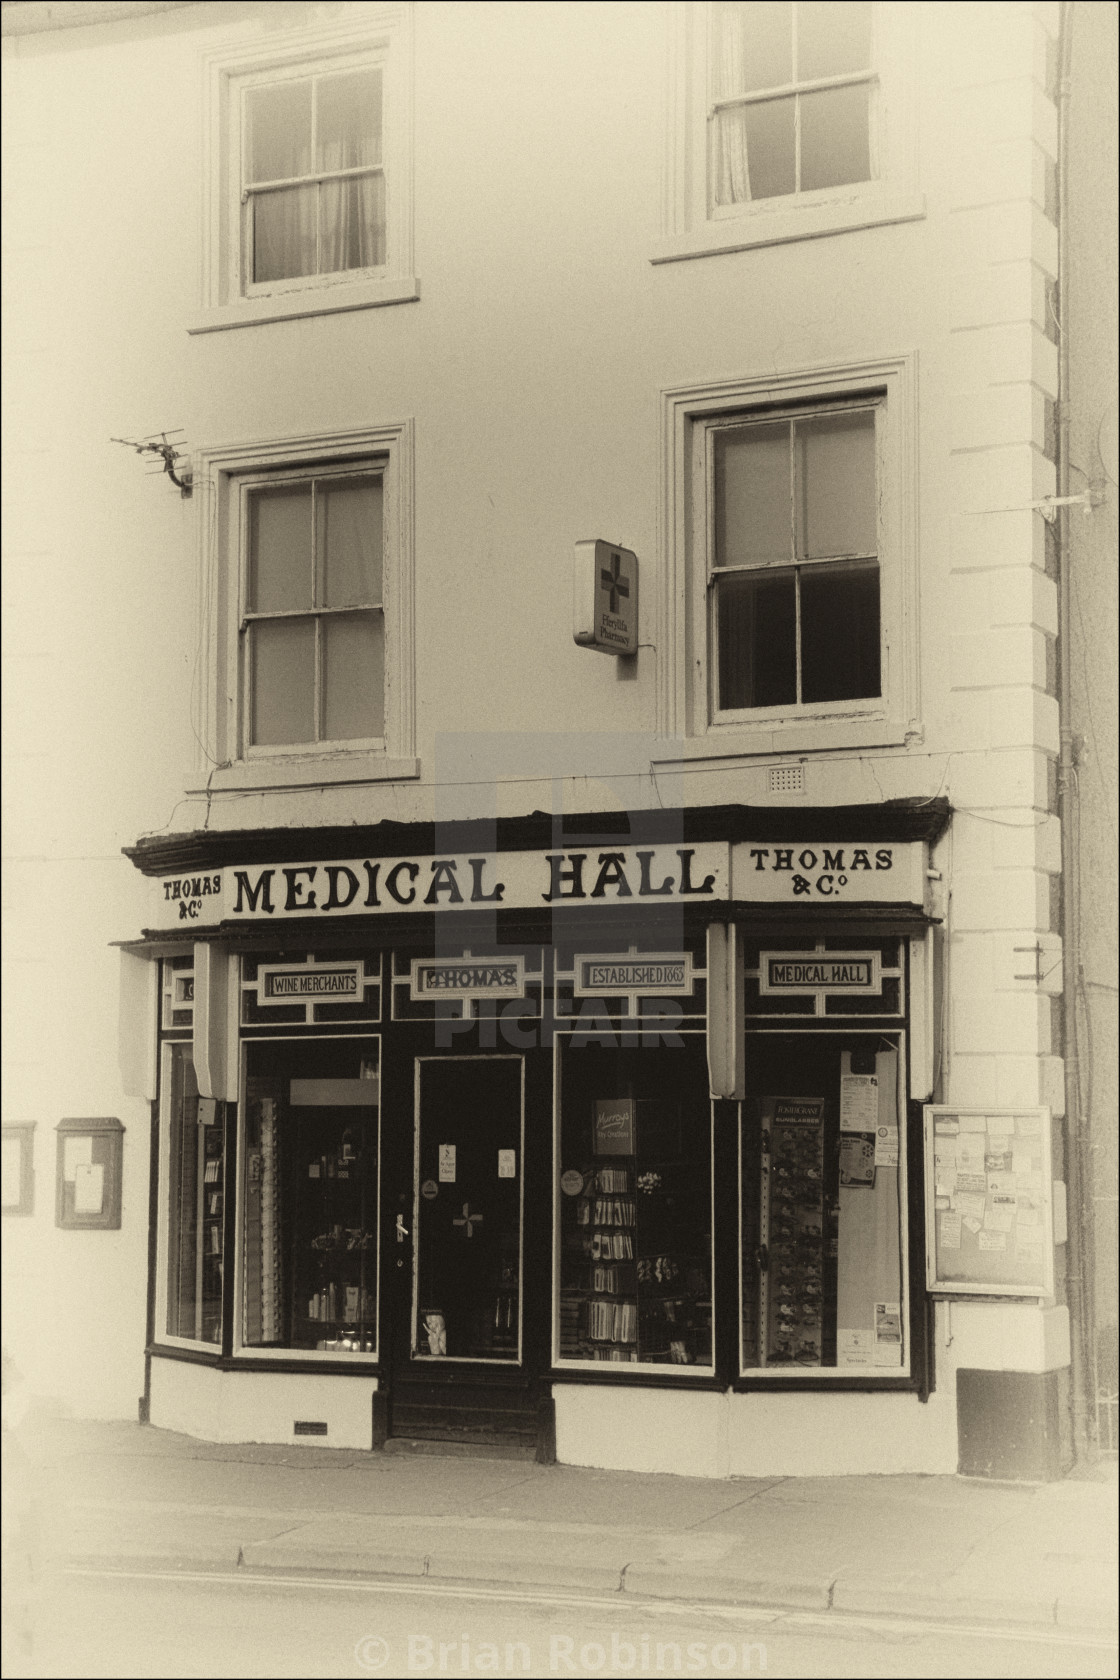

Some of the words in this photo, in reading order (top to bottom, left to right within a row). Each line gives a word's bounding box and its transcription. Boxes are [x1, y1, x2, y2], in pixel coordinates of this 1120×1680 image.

[750, 849, 893, 871] THOMAS
[163, 875, 221, 900] THOMAS
[232, 859, 506, 914] MEDICAL
[541, 849, 716, 902] HALL
[274, 977, 298, 992] WINE
[300, 974, 357, 992] MERCHANTS
[434, 968, 517, 988] THOMAS
[592, 966, 663, 984] ESTABLISHED
[664, 966, 684, 982] 1863
[774, 964, 828, 983] MEDICAL
[831, 964, 864, 982] HALL
